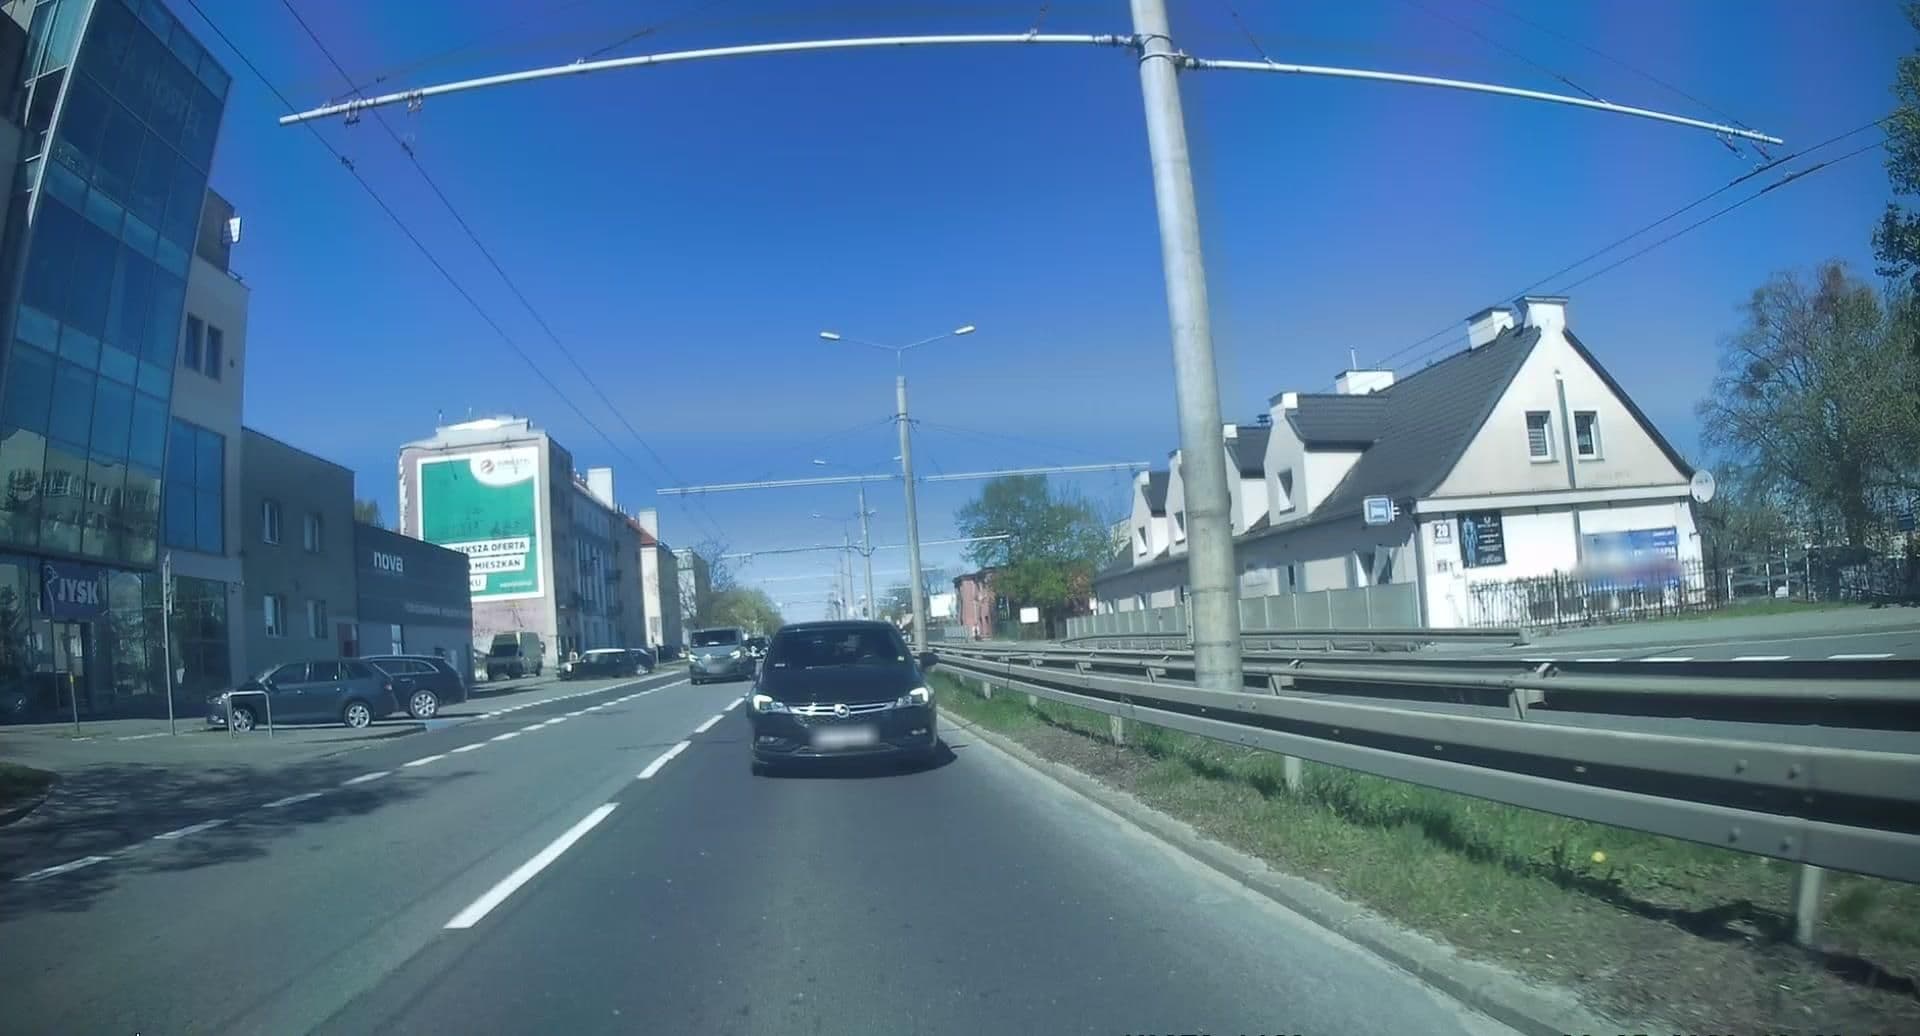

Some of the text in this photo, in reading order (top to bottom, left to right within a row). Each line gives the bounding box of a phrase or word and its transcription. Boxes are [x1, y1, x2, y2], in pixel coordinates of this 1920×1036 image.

[491, 541, 526, 551] OFERTA
[373, 551, 404, 572] nova
[57, 578, 99, 605] JYSK
